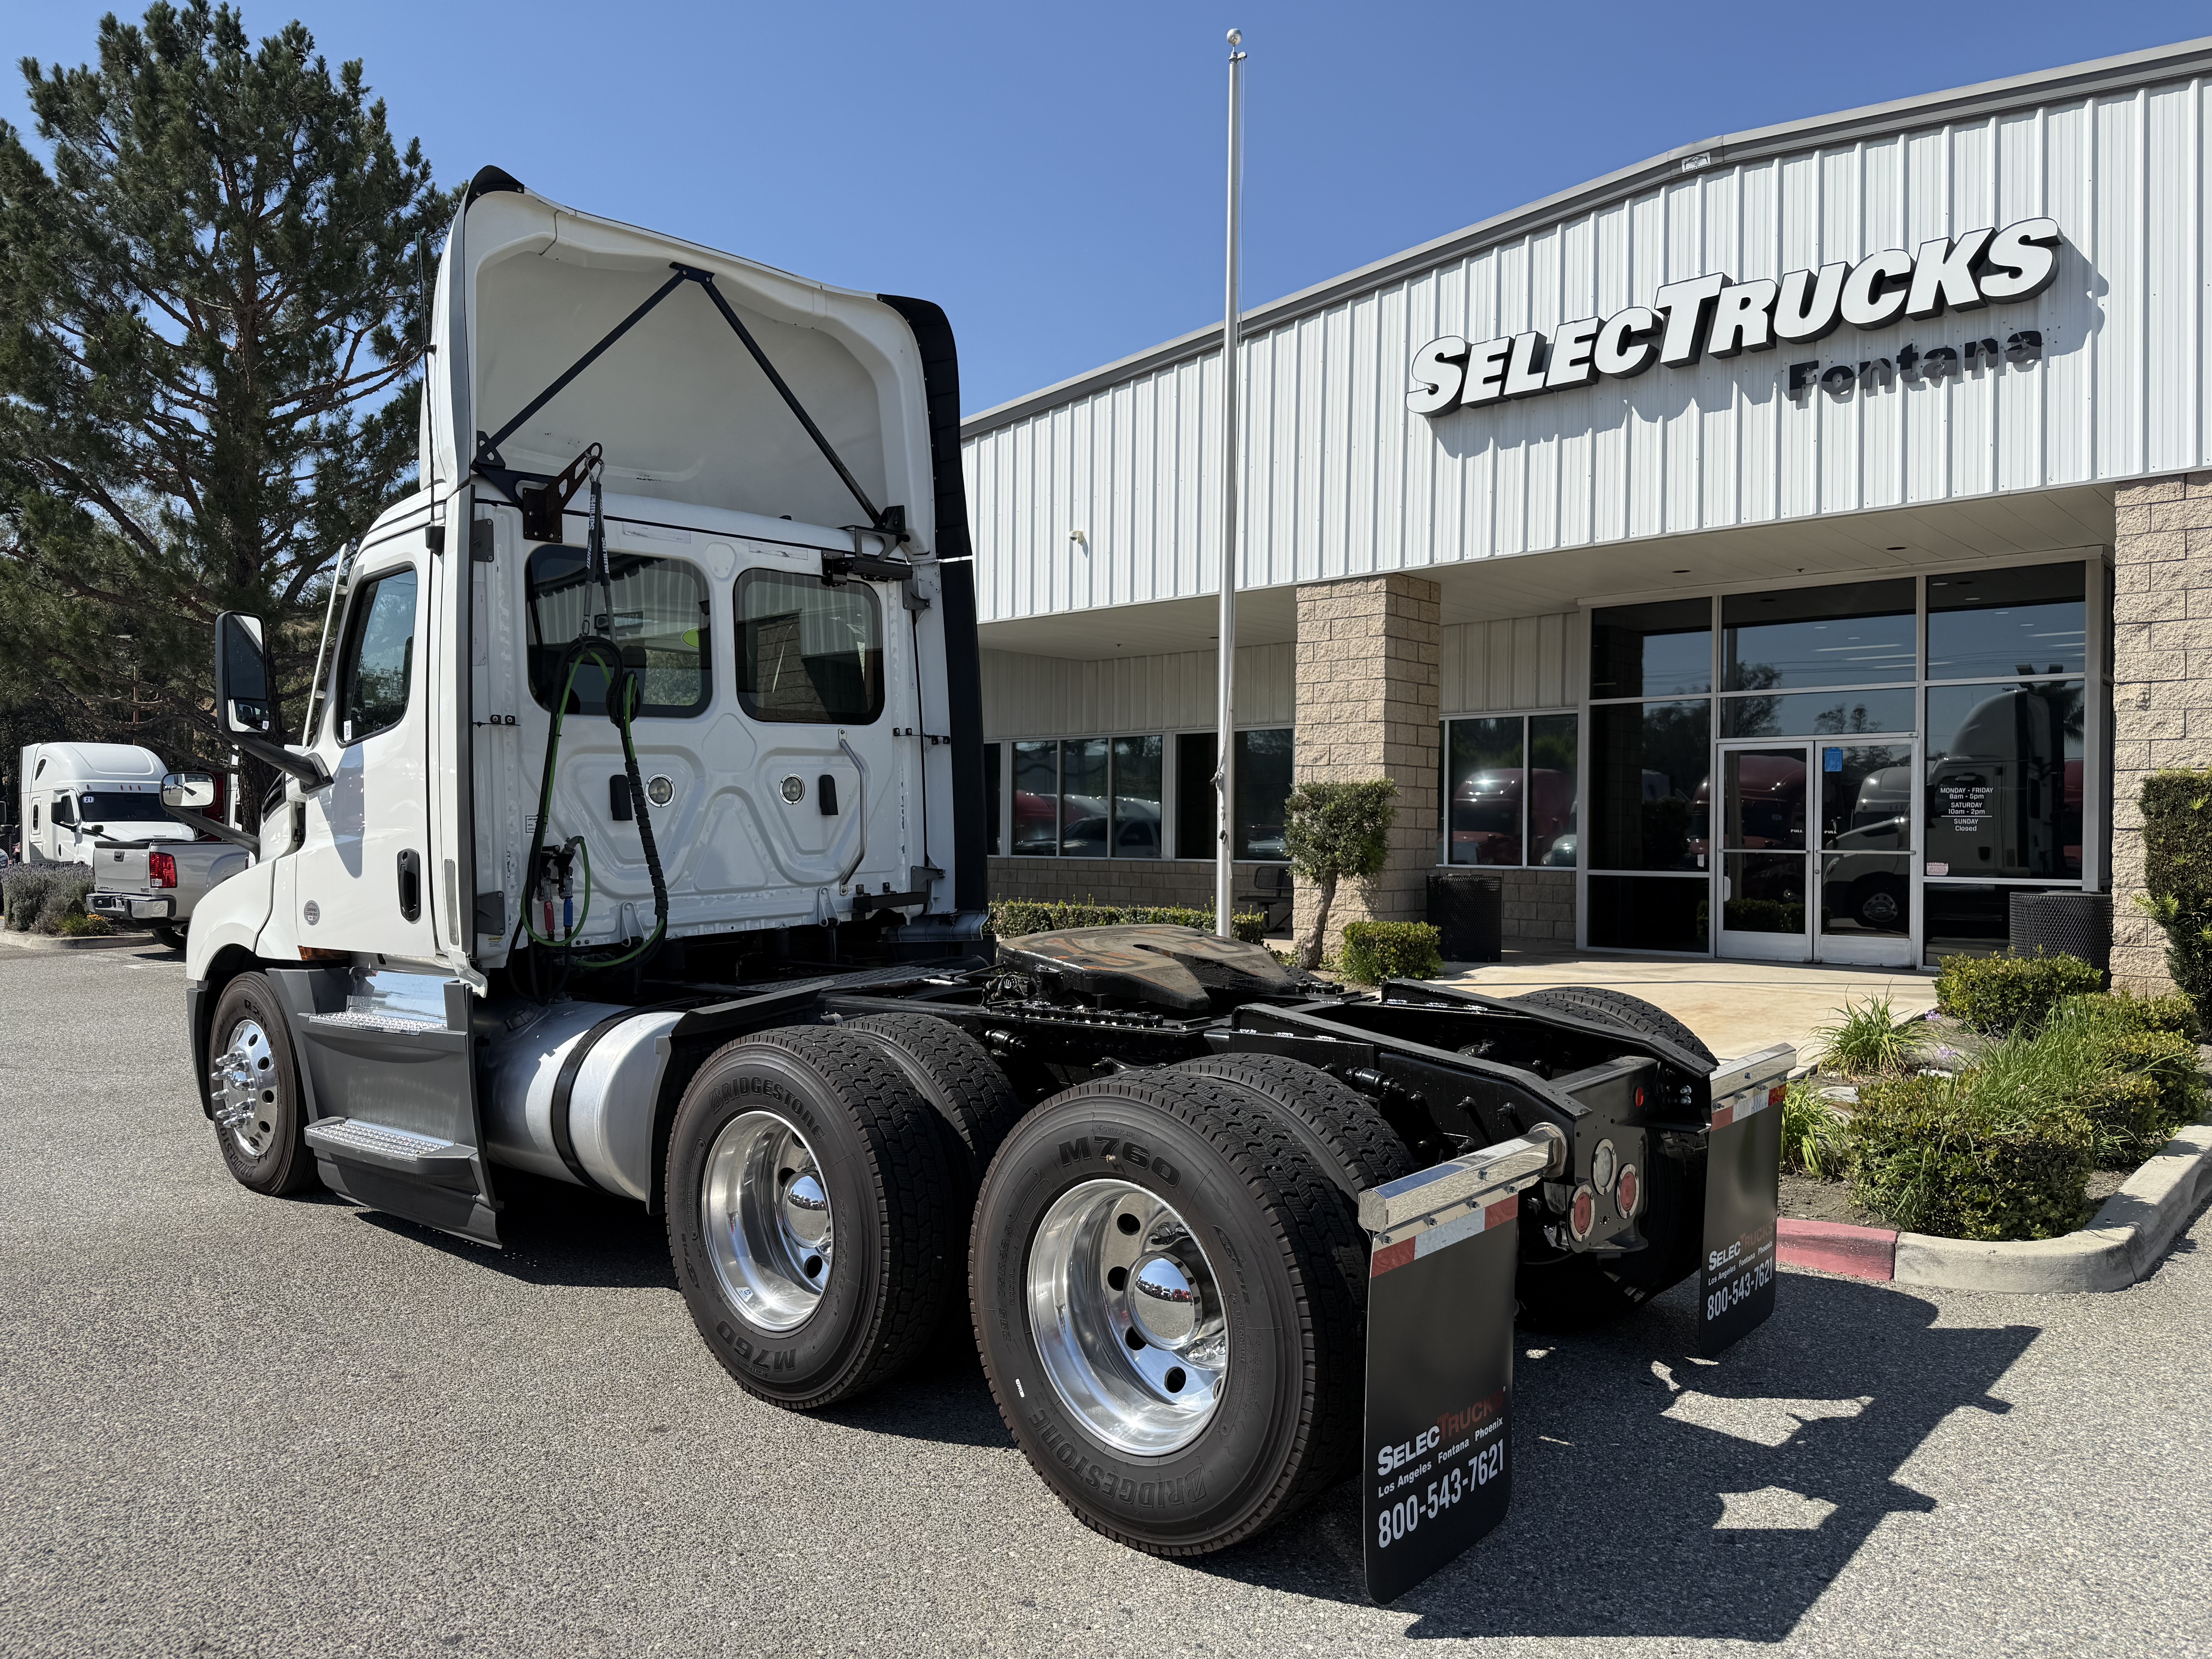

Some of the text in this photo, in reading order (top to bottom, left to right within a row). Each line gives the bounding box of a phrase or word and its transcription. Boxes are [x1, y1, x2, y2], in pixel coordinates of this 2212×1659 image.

[1406, 217, 2063, 418] SELECTRUCKS
[1789, 331, 2042, 400] Fontana
[709, 1076, 826, 1142] BRIDGESTONE
[1059, 1135, 1180, 1187] M760
[1708, 1240, 1773, 1286] Los Angeles Fontana Phoenix
[1709, 1223, 1773, 1271] SELECTRUCKS
[1707, 1256, 1773, 1321] 800-543-7621
[717, 1320, 797, 1371] M760
[1028, 1409, 1206, 1508] BRIDGESTONE
[1377, 1389, 1504, 1476] SELECTRUCKS
[1378, 1416, 1503, 1498] Los Angeles Fontana Phoenix
[1378, 1438, 1504, 1548] 800-543-7621
